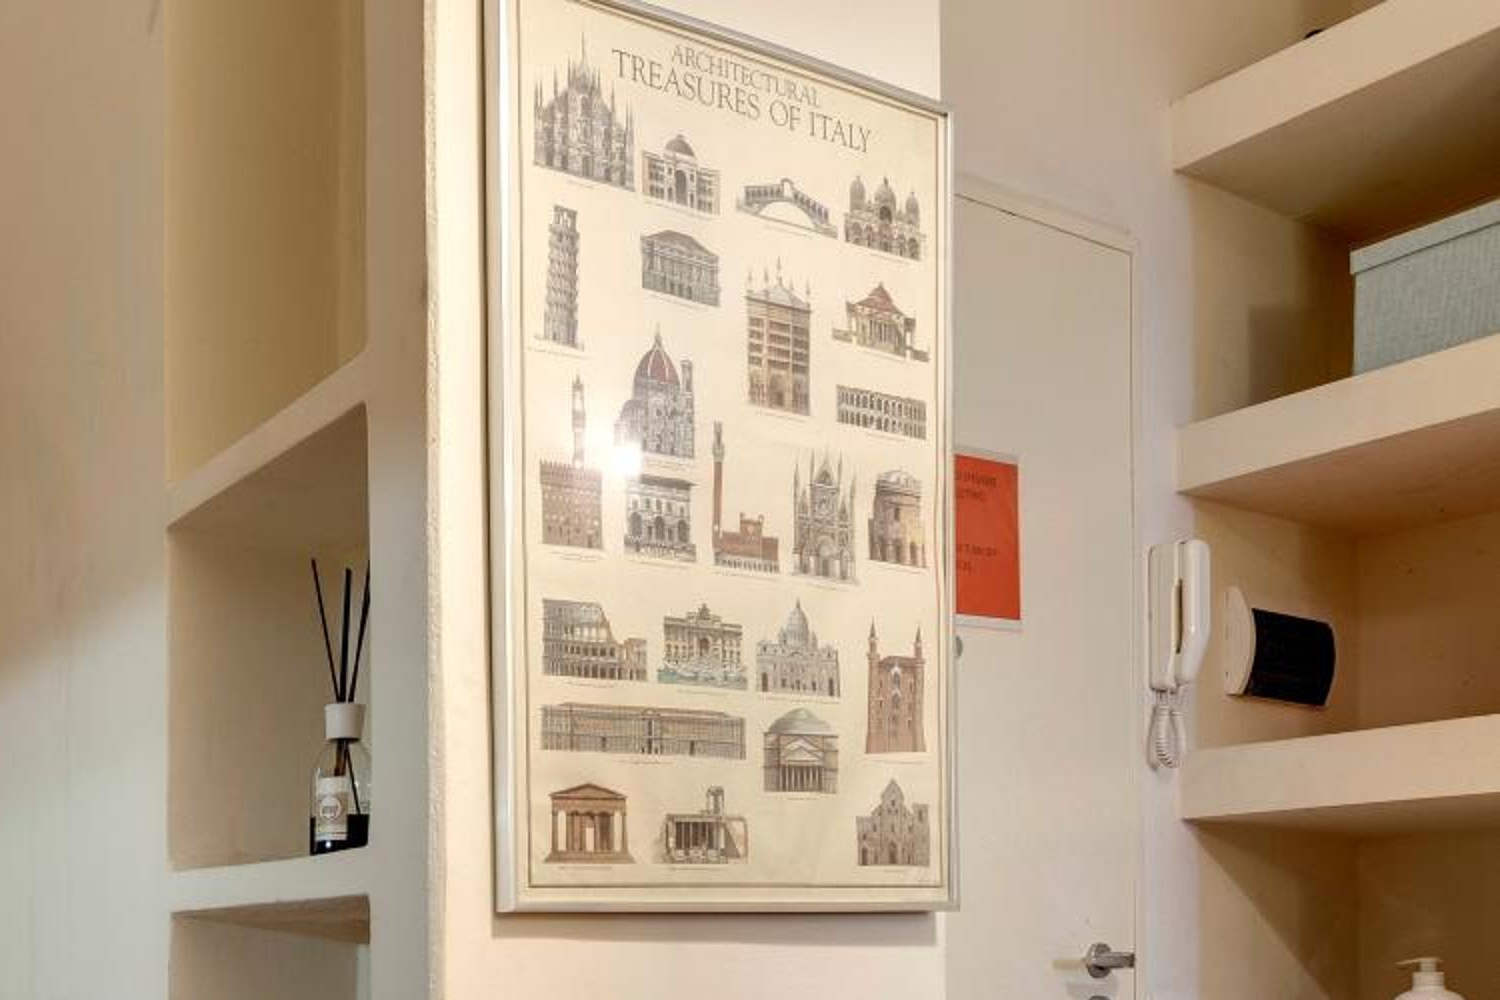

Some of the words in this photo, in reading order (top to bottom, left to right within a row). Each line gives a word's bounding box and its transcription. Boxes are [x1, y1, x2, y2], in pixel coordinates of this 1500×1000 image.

[611, 48, 761, 121] TREASURES
[769, 100, 801, 132] OF
[809, 110, 872, 154] ITALY
[671, 44, 821, 109] ARCHITECTURAL
